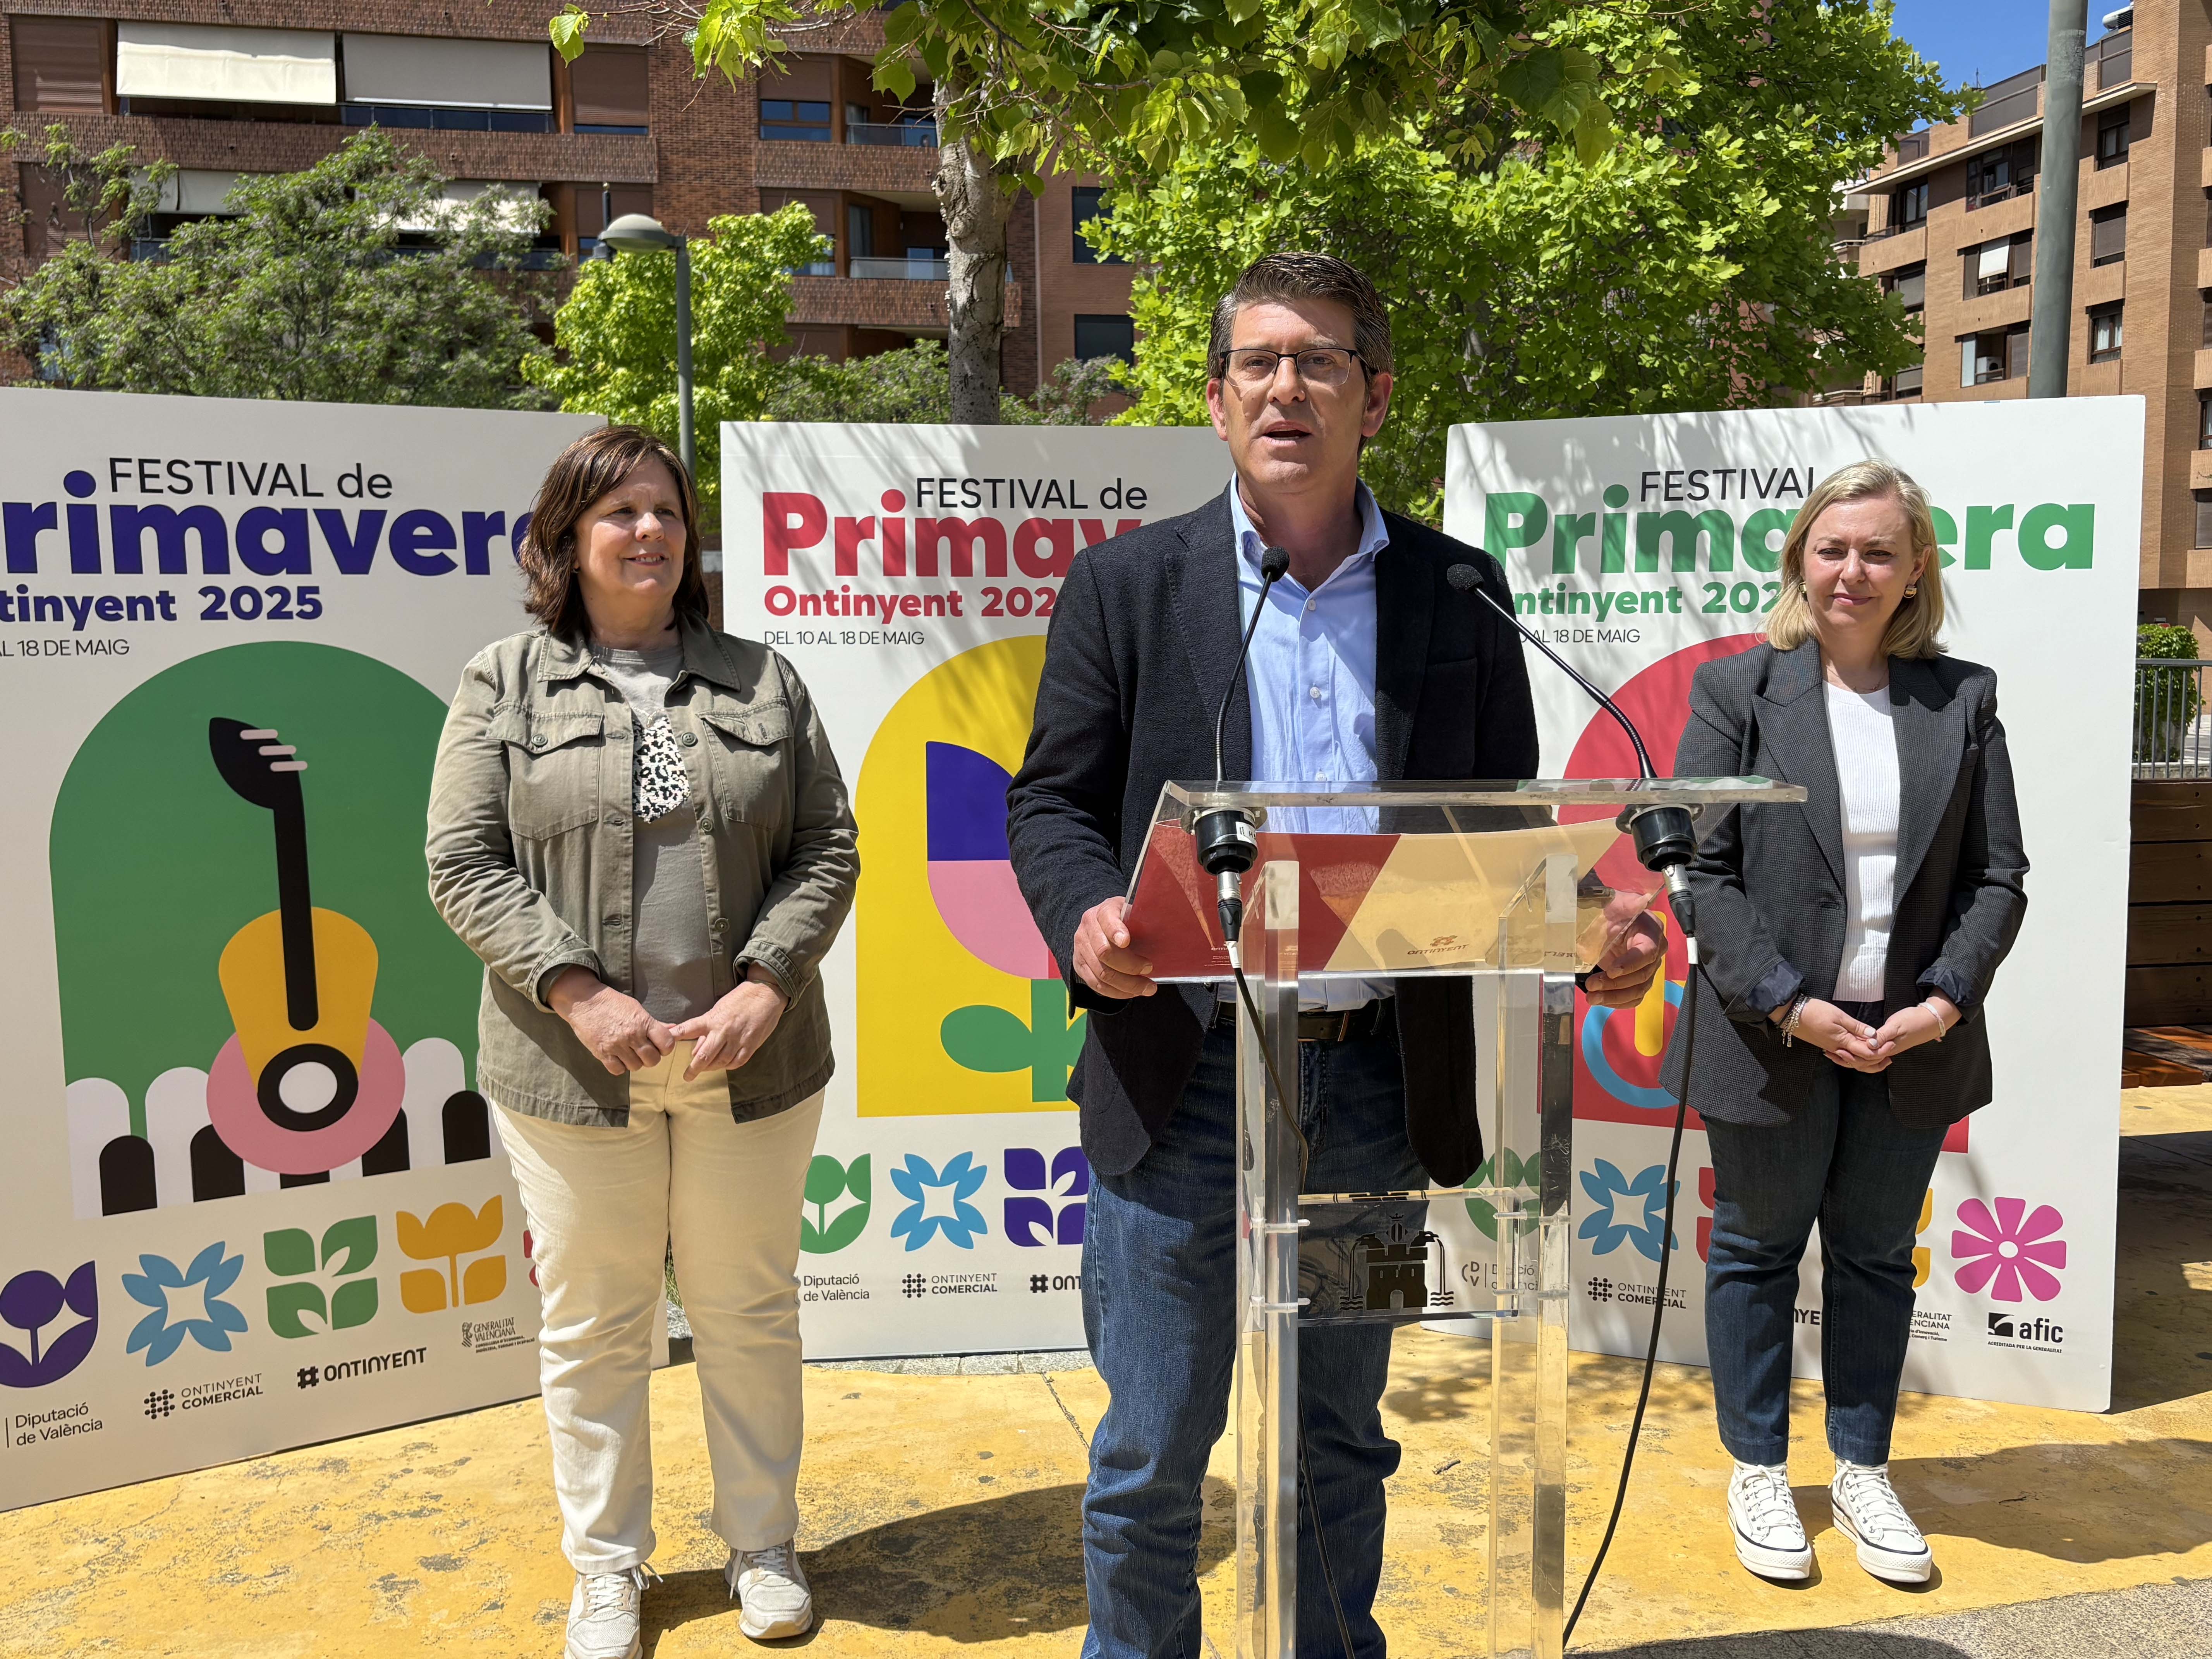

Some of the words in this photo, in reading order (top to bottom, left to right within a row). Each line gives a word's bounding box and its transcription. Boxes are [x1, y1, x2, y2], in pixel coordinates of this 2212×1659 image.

[110, 458, 324, 497] FESTIVAL
[337, 462, 393, 499] de
[917, 478, 1087, 509] FESTIVAL
[1099, 477, 1147, 509] de
[2, 470, 534, 575] rimaver
[198, 586, 323, 620] 2025
[764, 584, 963, 624] Ontinyent
[764, 631, 794, 644] DEL
[796, 631, 814, 644] 10
[817, 631, 837, 644] AL
[840, 631, 856, 644] 18
[860, 631, 880, 644] DE
[883, 631, 924, 645] MAIG
[1553, 629, 1569, 642] 18
[1573, 630, 1594, 642] DE
[1598, 629, 1640, 643] MAIG
[0, 640, 14, 657] L
[17, 640, 39, 656] 18
[44, 640, 71, 656] DE
[76, 639, 130, 656] MAIG
[804, 1273, 860, 1288] Diputació
[931, 1273, 997, 1284] ONTINYENT
[931, 1284, 998, 1294] COMERCIAL
[804, 1291, 819, 1301] de
[821, 1289, 870, 1301] València
[1618, 1283, 1686, 1298] ONTINENT
[474, 1317, 514, 1333] GENERALITAT
[474, 1326, 516, 1342] VALENCIANA
[2019, 1317, 2063, 1343] afic
[181, 1373, 262, 1398] ONTINYENT
[182, 1386, 263, 1410] COMERCIAL
[15, 1401, 89, 1429] Diputació
[16, 1432, 36, 1446] de
[40, 1418, 103, 1441] València
